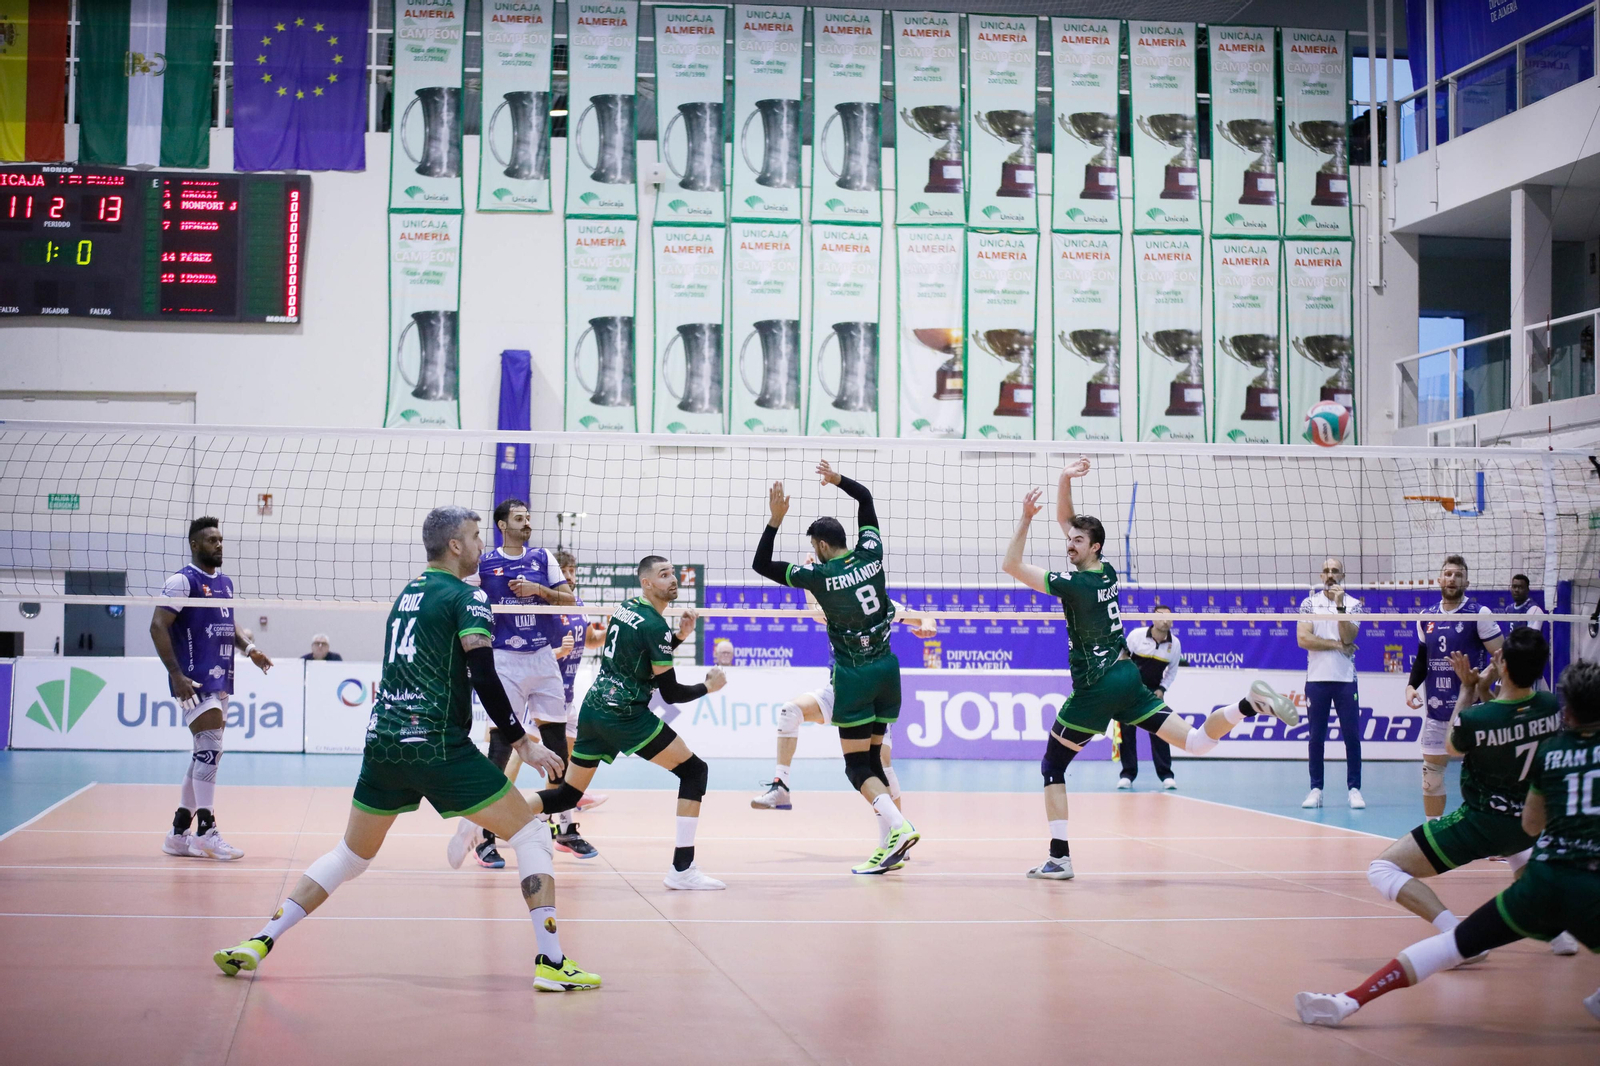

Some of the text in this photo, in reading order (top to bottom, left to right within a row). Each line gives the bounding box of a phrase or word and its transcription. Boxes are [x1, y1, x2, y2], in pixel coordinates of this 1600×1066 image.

[495, 3, 540, 11] UNICAJA
[581, 5, 625, 14] UNICAJA
[404, 9, 455, 19] ALMERÍA
[668, 14, 713, 23] UNICAJA
[747, 11, 791, 20] UNICAJA
[826, 14, 870, 23] UNICAJA
[492, 14, 543, 24] ALMERÍA
[578, 17, 627, 26] ALMERÍA
[905, 17, 948, 26] UNICAJA
[665, 25, 715, 35] ALMERÍA
[744, 22, 793, 32] ALMERÍA
[823, 25, 872, 35] ALMERÍA
[981, 21, 1025, 30] UNICAJA
[1064, 24, 1107, 33] UNICAJA
[902, 28, 950, 37] ALMERÍA
[1140, 26, 1183, 35] UNICAJA
[978, 32, 1027, 42] ALMERÍA
[1061, 35, 1110, 45] ALMERÍA
[1220, 32, 1262, 41] UNICAJA
[1293, 33, 1335, 42] UNICAJA
[1138, 37, 1186, 47] ALMERÍA
[1218, 42, 1265, 52] ALMERÍA
[1291, 44, 1338, 54] ALMERÍA
[424, 194, 449, 202] Unicaja
[512, 195, 537, 203] Unicaja
[10, 196, 32, 218] 11
[50, 198, 64, 218] 2
[99, 197, 122, 221] 13
[164, 200, 170, 209] 4
[764, 204, 788, 212] Unicaja
[688, 207, 712, 215] Unicaja
[844, 207, 869, 215] Unicaja
[929, 209, 953, 217] Unicaja
[1000, 214, 1024, 222] Unicaja
[1084, 216, 1108, 224] Unicaja
[1165, 215, 1188, 223] Unicaja
[162, 222, 170, 230] 7
[403, 220, 447, 229] UNICAJA
[1243, 221, 1267, 229] Unicaja
[1316, 222, 1339, 230] Unicaja
[578, 226, 624, 235] UNICAJA
[743, 230, 788, 238] UNICAJA
[666, 233, 711, 242] UNICAJA
[824, 232, 868, 240] UNICAJA
[910, 233, 953, 241] UNICAJA
[980, 240, 1024, 248] UNICAJA
[1064, 239, 1107, 248] UNICAJA
[1146, 241, 1189, 249] UNICAJA
[76, 240, 92, 265] 0
[908, 244, 956, 253] ALMERÍA
[1224, 246, 1267, 255] UNICAJA
[1296, 247, 1339, 255] UNICAJA
[162, 253, 176, 262] 14
[977, 250, 1027, 260] ALMERÍA
[1061, 250, 1110, 260] ALMERÍA
[1144, 251, 1192, 261] ALMERÍA
[1222, 257, 1270, 267] ALMERÍA
[1294, 258, 1342, 267] ALMERÍA
[598, 423, 623, 431] Unicaja
[763, 426, 787, 434] Unicaja
[1086, 433, 1109, 441] Unicaja
[1170, 432, 1193, 440] Unicaja
[578, 566, 591, 574] DE
[398, 592, 424, 612] RUIZ
[855, 584, 880, 616] 8
[1108, 601, 1122, 632] 9
[575, 626, 584, 642] 12
[388, 618, 416, 663] 14
[604, 624, 619, 658] 3
[1438, 636, 1446, 652] 3
[734, 646, 793, 658] DIPUTACIÓN
[946, 648, 1012, 661] DIPUTACIÓN
[735, 659, 748, 667] DE
[906, 691, 1067, 747] Jom
[1475, 724, 1524, 746] PAULO
[1516, 741, 1538, 782] 7
[1544, 749, 1588, 771] FRAN
